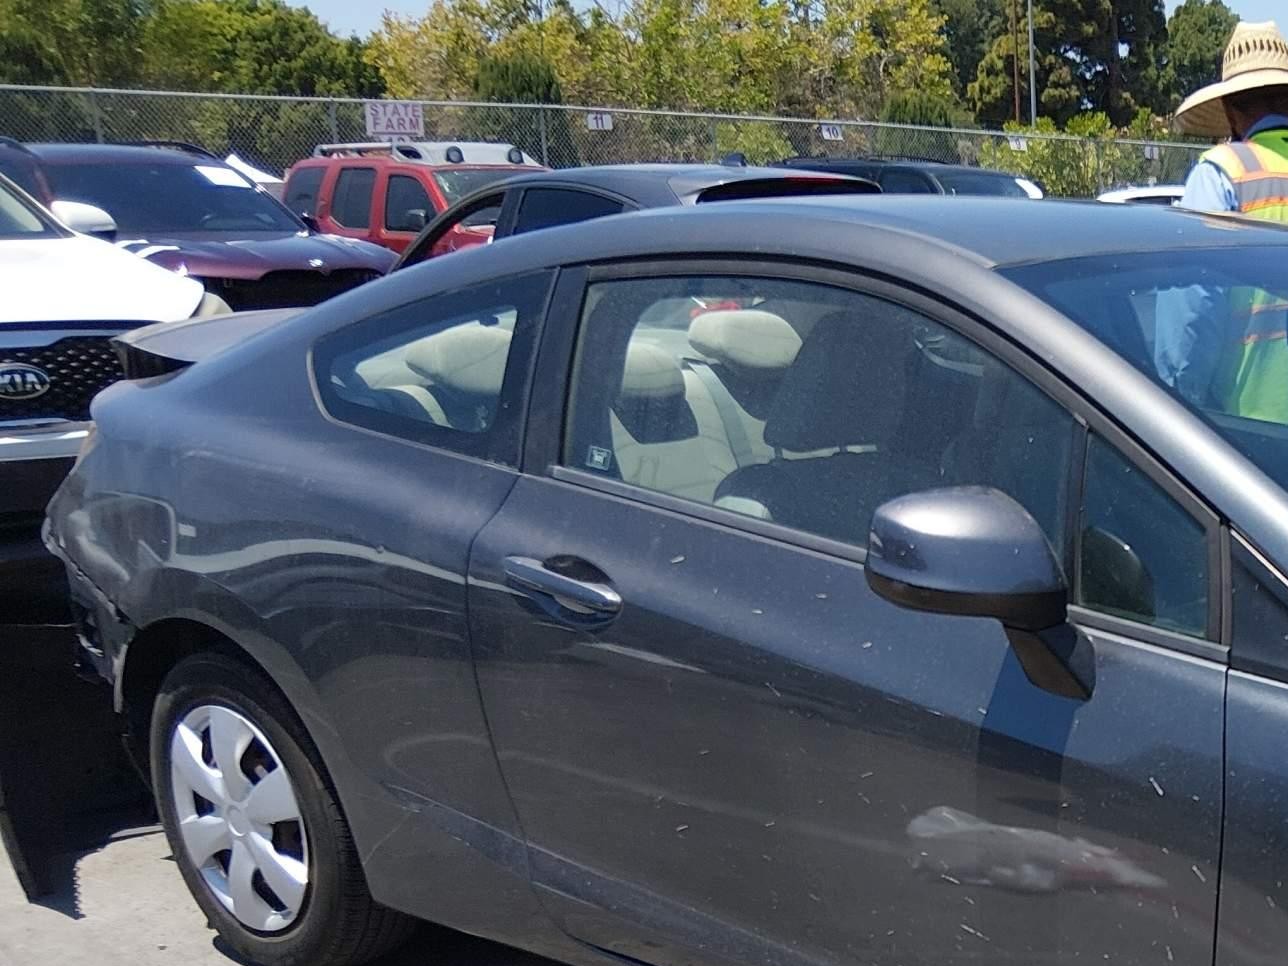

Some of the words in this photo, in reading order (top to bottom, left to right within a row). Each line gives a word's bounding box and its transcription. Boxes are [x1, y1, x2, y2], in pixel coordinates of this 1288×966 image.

[370, 103, 420, 117] STATE
[373, 117, 419, 130] FARM
[827, 126, 839, 138] 10
